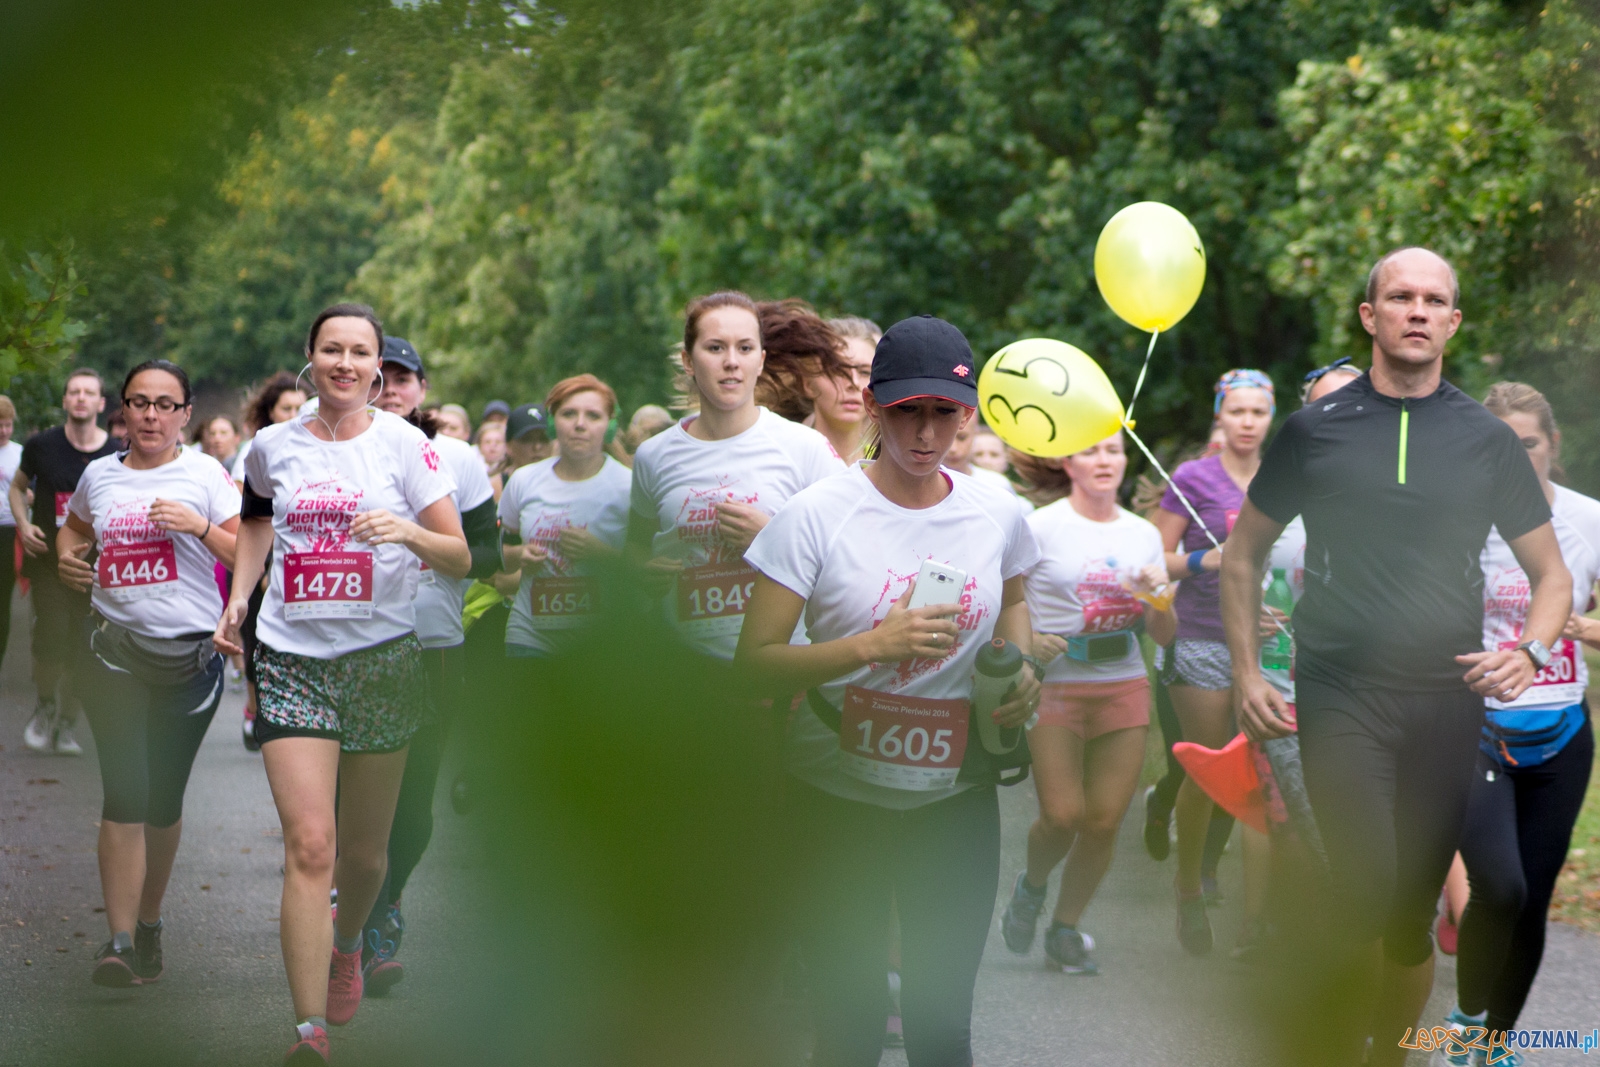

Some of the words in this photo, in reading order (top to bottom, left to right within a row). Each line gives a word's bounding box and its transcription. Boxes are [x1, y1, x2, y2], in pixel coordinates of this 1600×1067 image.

[296, 499, 357, 512] zawsze
[686, 507, 720, 523] zaw
[290, 525, 314, 533] 2016
[107, 557, 169, 586] 1446
[293, 572, 363, 598] 1478
[1496, 585, 1531, 596] zaw
[538, 592, 593, 613] 1654
[872, 701, 899, 712] Zawsze
[900, 706, 931, 716] Pier(w)si
[932, 709, 950, 717] 2016
[856, 719, 953, 763] 1605
